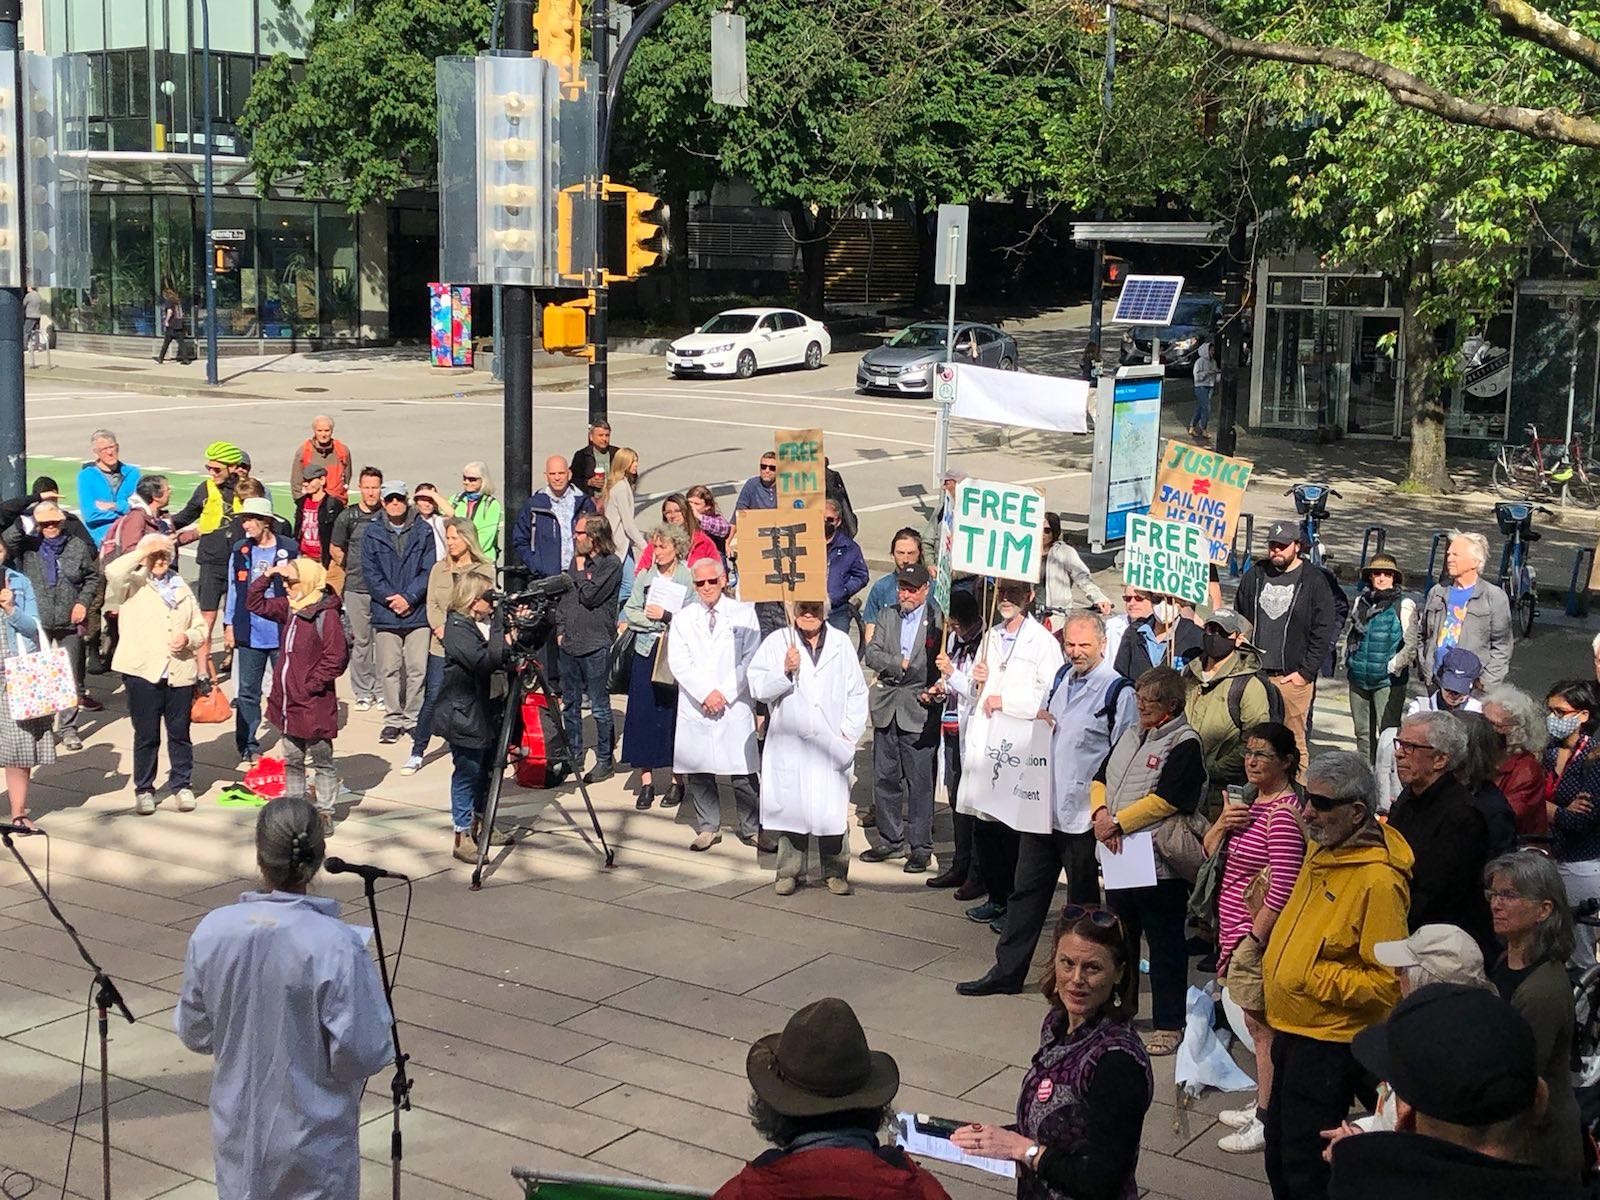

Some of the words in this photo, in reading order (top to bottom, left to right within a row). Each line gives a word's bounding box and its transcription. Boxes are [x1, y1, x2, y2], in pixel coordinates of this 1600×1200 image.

[778, 440, 819, 463] FREE
[1168, 445, 1250, 488] JUSTICE
[780, 471, 818, 493] TIM
[1160, 485, 1226, 517] JAILING
[962, 487, 1039, 528] FREE
[959, 524, 1033, 574] TIM
[1132, 518, 1199, 559] FREE
[1127, 562, 1207, 604] HEROES
[1128, 546, 1151, 564] the
[1153, 551, 1209, 584] CLIMATE
